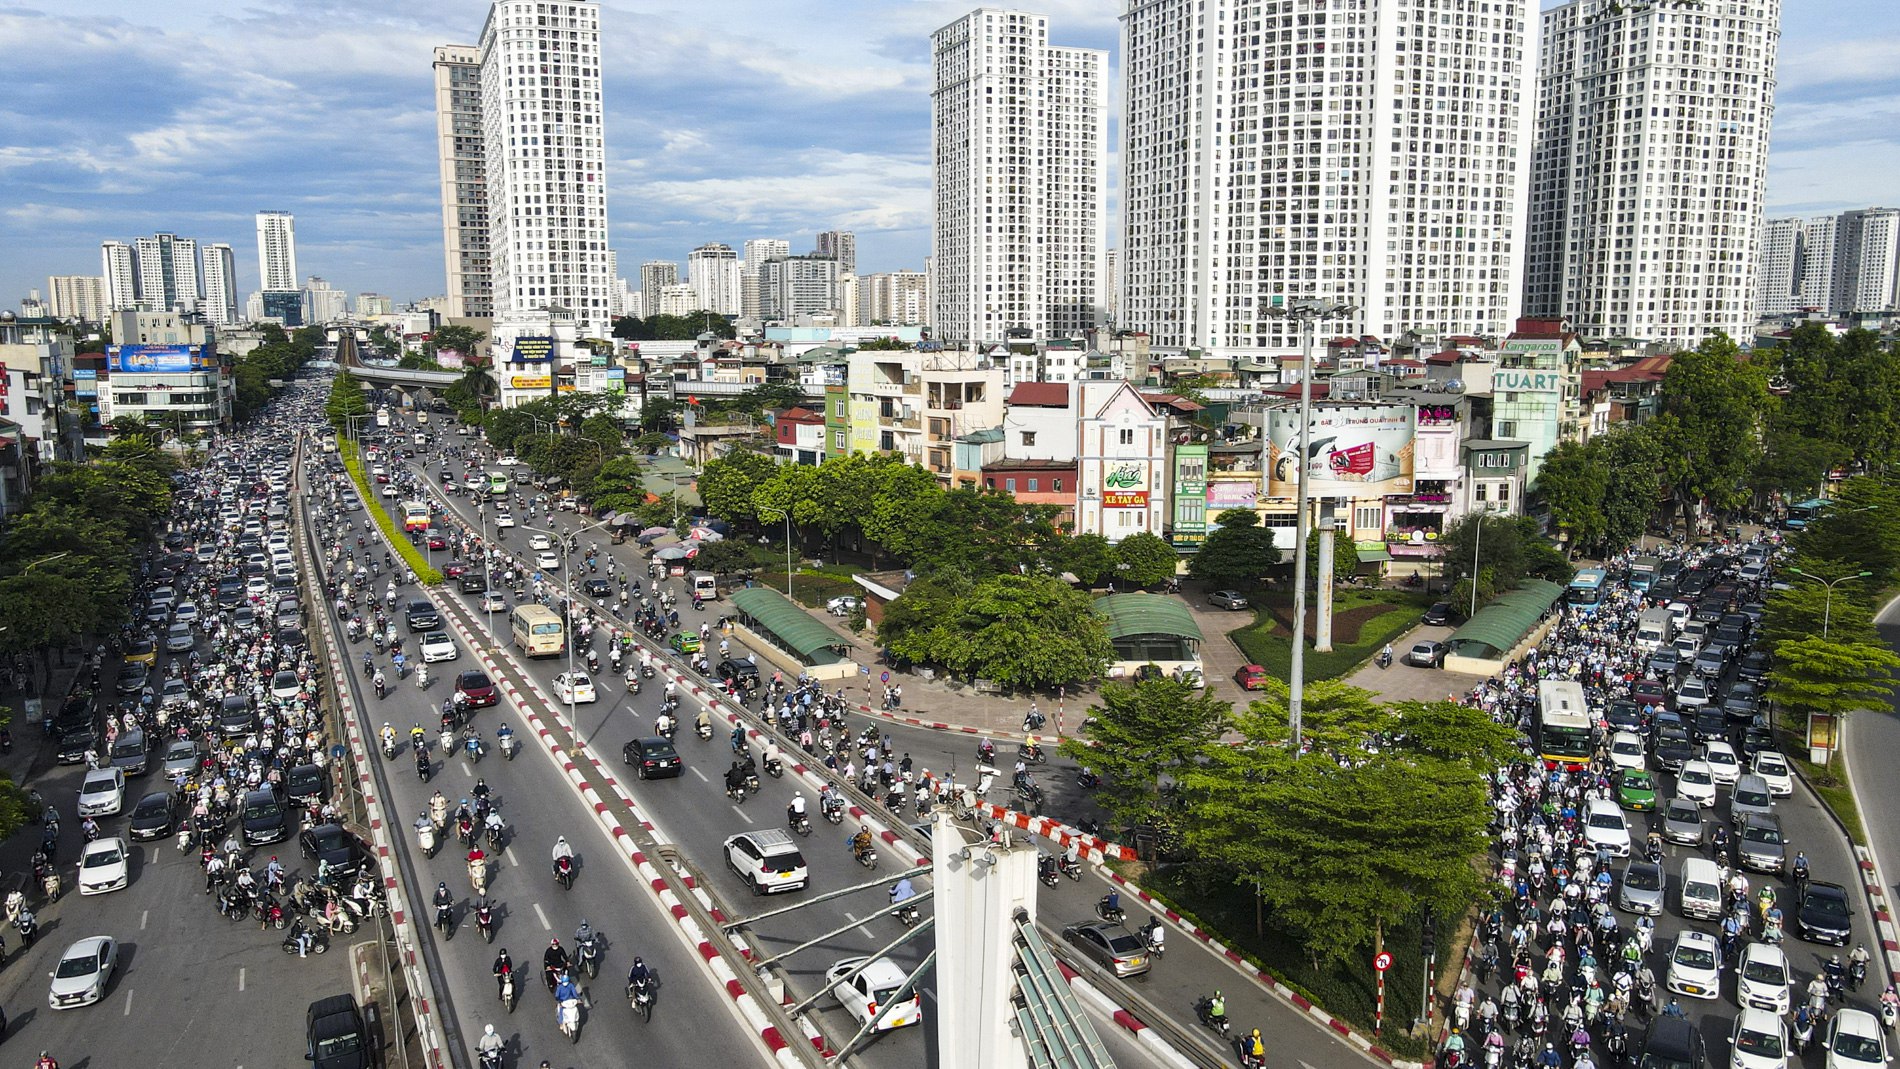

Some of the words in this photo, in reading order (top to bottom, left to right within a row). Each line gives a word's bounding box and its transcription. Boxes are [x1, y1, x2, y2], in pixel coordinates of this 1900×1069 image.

[1505, 341, 1557, 352] Kangaroo
[1494, 373, 1558, 390] TUART
[1105, 495, 1117, 504] XE
[1117, 495, 1133, 504] TAY
[1134, 495, 1145, 504] GA
